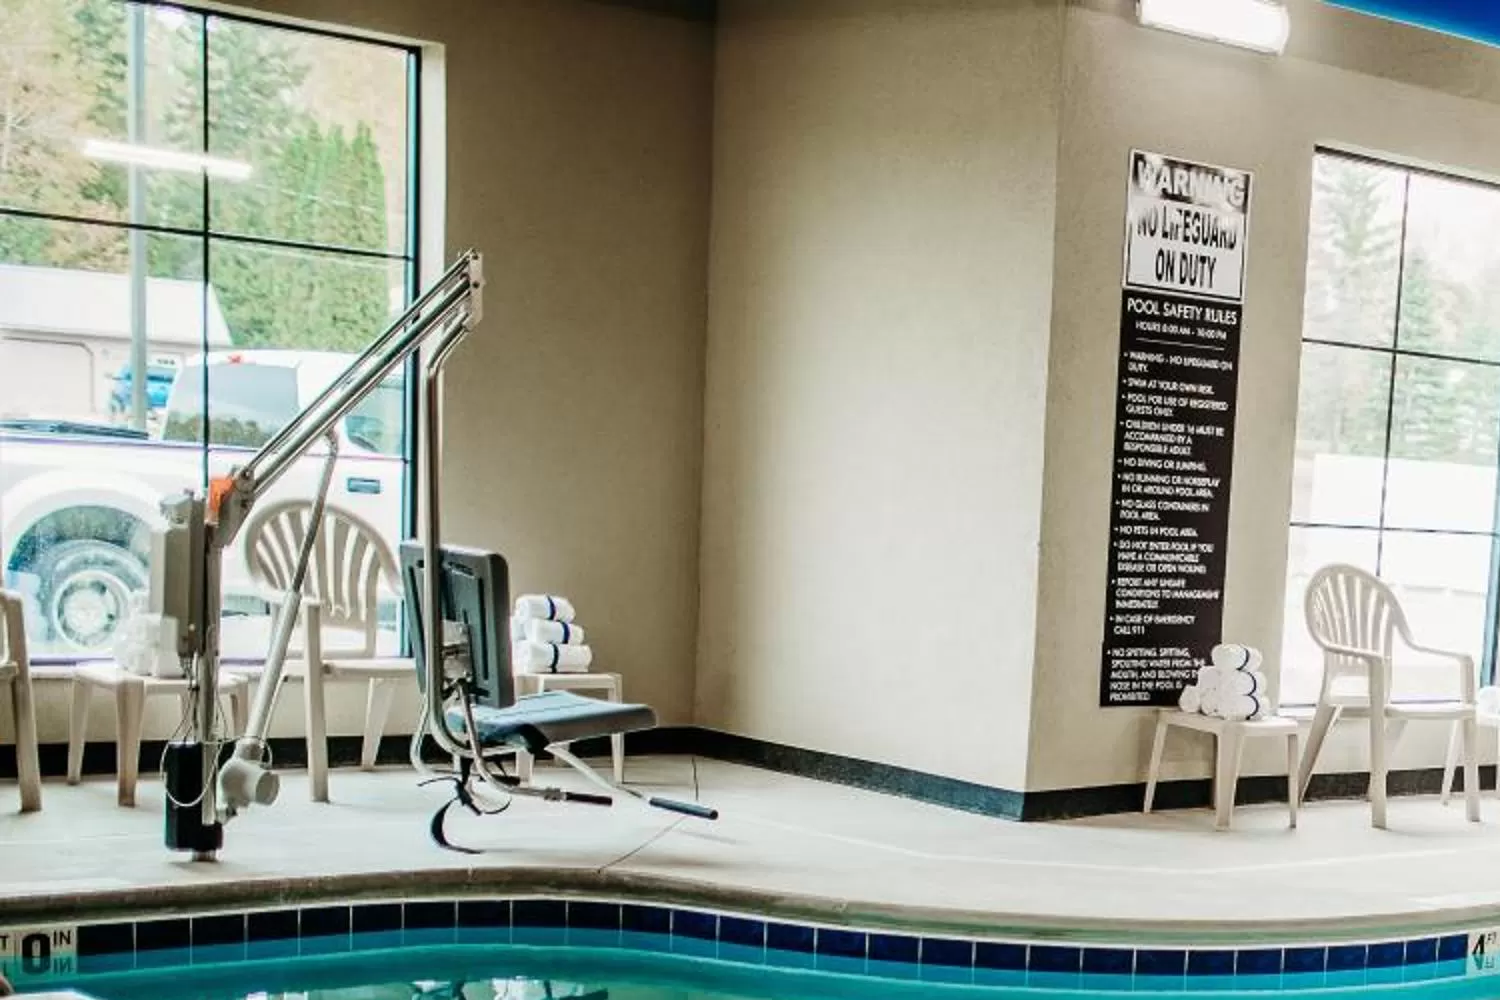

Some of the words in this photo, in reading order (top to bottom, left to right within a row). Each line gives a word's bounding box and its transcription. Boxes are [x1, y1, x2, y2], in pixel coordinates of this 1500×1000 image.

[1137, 207, 1158, 237] NO
[1161, 206, 1237, 250] LIFEGUARD
[1155, 247, 1176, 283] ON
[1179, 252, 1217, 289] DUTY
[1127, 297, 1160, 315] POOL
[1163, 302, 1203, 320] SAFETY
[1204, 307, 1237, 325] RULES
[1135, 320, 1160, 333] HOURS
[1129, 351, 1164, 363] WARNING
[1169, 355, 1182, 365] NO
[1184, 356, 1220, 369] LIFEGUARD
[1220, 360, 1233, 371] ON
[1128, 377, 1146, 387] SWIM
[1147, 380, 1157, 389] AT
[1158, 380, 1178, 391] YOUR
[1179, 382, 1198, 393] OWN
[1127, 393, 1146, 404] POOL
[1148, 394, 1162, 405] FOR
[1163, 396, 1177, 407] USE
[1178, 397, 1189, 407] OF
[1189, 399, 1229, 411] REGISTERED
[1126, 404, 1152, 415] GUESTS
[1126, 420, 1161, 431] CHILDREN
[1161, 422, 1185, 433] UNDER
[1196, 425, 1215, 436] MUST
[1215, 427, 1225, 437] BE
[1124, 431, 1176, 443] ACCOMPANIED
[1177, 435, 1186, 444] BY
[1186, 436, 1193, 445] A
[1123, 442, 1168, 454] RESPONSIBLE
[1124, 457, 1137, 467] NO
[1137, 458, 1162, 469] DIVING
[1163, 460, 1175, 470] OR
[1122, 472, 1135, 482] NO
[1136, 473, 1170, 484] RUNNING
[1171, 475, 1182, 485] OR
[1182, 476, 1221, 488] HORSEPLAY
[1121, 484, 1131, 493] IN
[1131, 484, 1142, 493] OR
[1143, 485, 1175, 495] AROUND
[1175, 486, 1195, 497] POOL
[1121, 499, 1135, 509] NO
[1135, 500, 1156, 510] GLASS
[1157, 501, 1201, 512] CONTAINERS
[1201, 503, 1210, 512] IN
[1120, 509, 1139, 519] POOL
[1120, 525, 1132, 535] NO
[1133, 525, 1148, 535] PETS
[1149, 526, 1159, 535] IN
[1160, 527, 1179, 537] POOL
[1119, 540, 1131, 549] DO
[1131, 540, 1148, 550] NOT
[1149, 541, 1171, 551] ENTER
[1171, 541, 1189, 552] POOL
[1197, 543, 1215, 553] YOU
[1118, 551, 1137, 560] HAVE
[1137, 552, 1143, 561] A
[1118, 562, 1144, 572] DISEASE
[1145, 563, 1157, 572] OR
[1157, 563, 1177, 573] OPEN
[1117, 577, 1143, 587] REPORT
[1143, 578, 1158, 587] ANY
[1159, 578, 1186, 589] UNSAFE
[1115, 588, 1160, 599] CONDITIONS
[1161, 589, 1172, 599] TO
[1115, 614, 1124, 624] IN
[1125, 614, 1142, 624] CASE
[1143, 614, 1153, 624] OF
[1113, 625, 1131, 635] CALL
[1131, 625, 1145, 635] 911
[1111, 647, 1125, 657] NO
[1149, 659, 1171, 668] WATER
[1171, 658, 1193, 668] FROM
[1140, 670, 1157, 679] AND
[1158, 670, 1191, 679] BLOWING
[1110, 681, 1130, 691] NOSE
[1131, 681, 1140, 690] IN
[1141, 681, 1154, 690] THE
[1155, 681, 1174, 690] POOL
[0, 935, 9, 951] T
[22, 934, 51, 959] 0
[53, 929, 71, 947] IN
[1472, 934, 1485, 957] 4
[1487, 933, 1497, 945] FT
